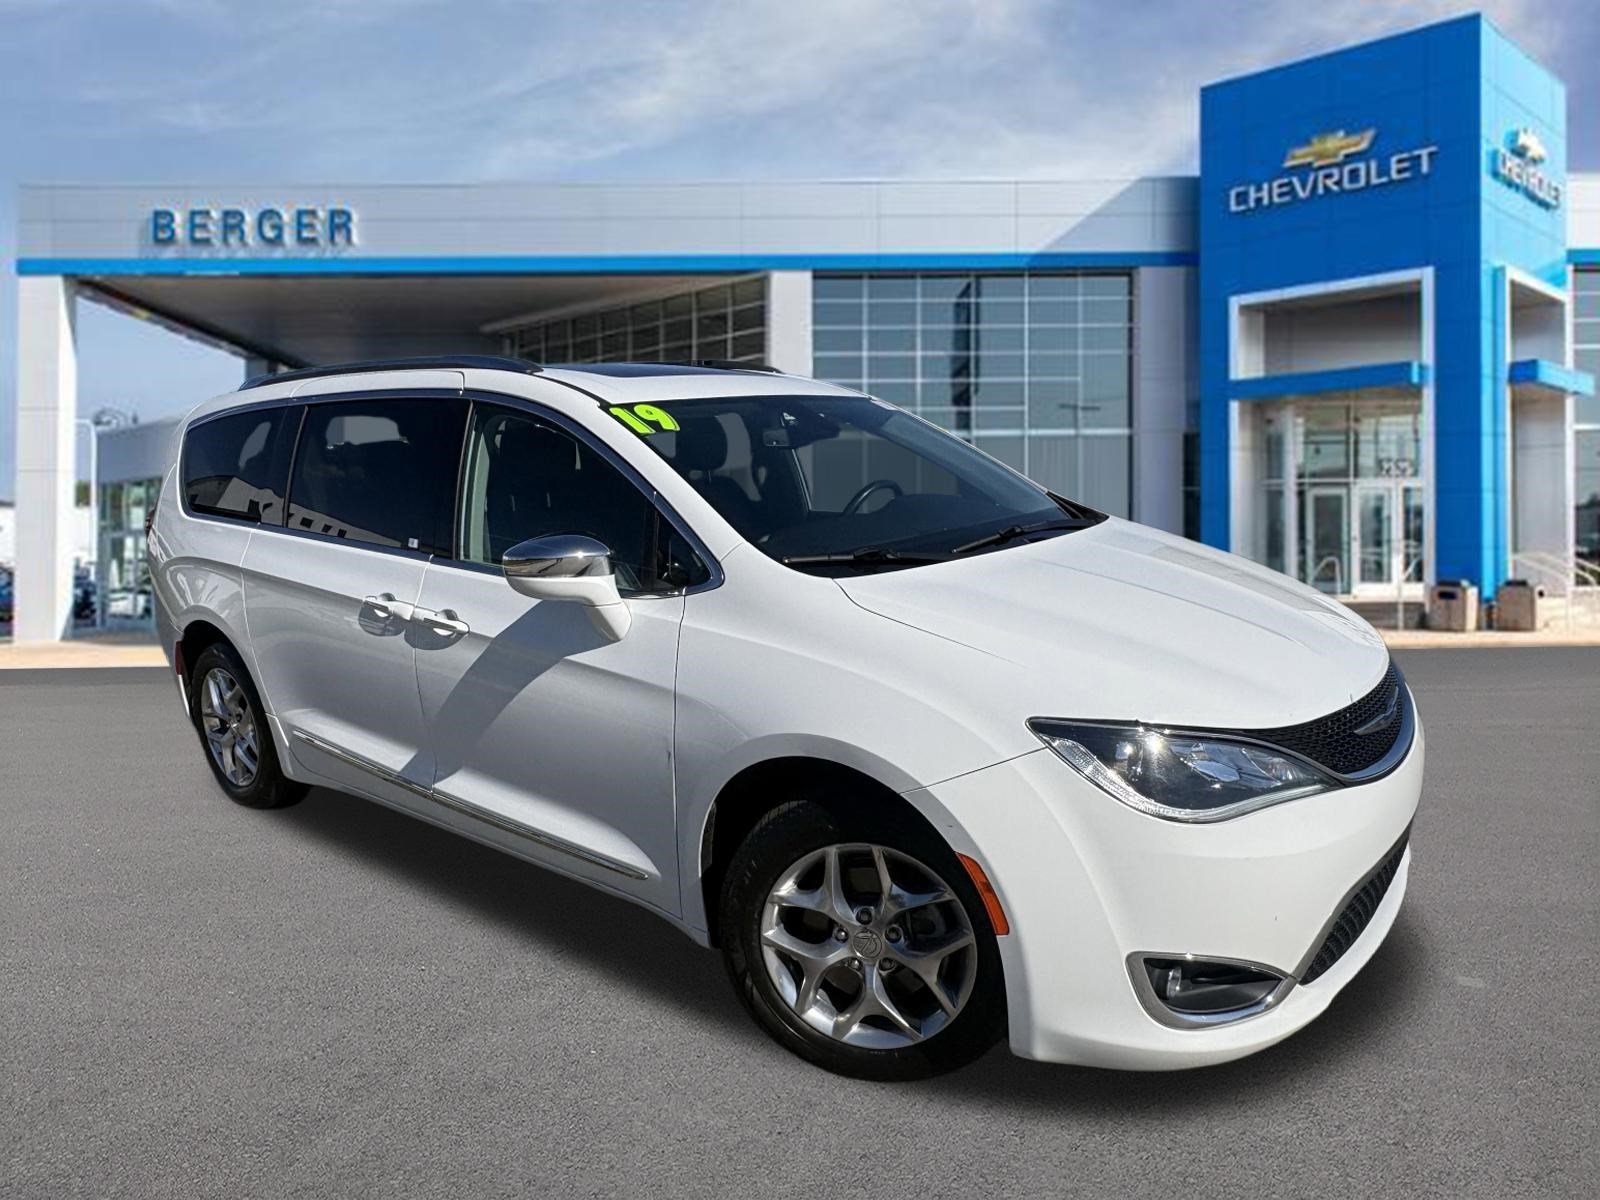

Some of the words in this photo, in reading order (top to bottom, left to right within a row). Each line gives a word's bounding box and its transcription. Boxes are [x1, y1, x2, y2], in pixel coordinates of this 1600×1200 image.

[1229, 146, 1438, 213] CHEVROLET
[152, 208, 356, 246] BERGER
[608, 404, 681, 435] 19
